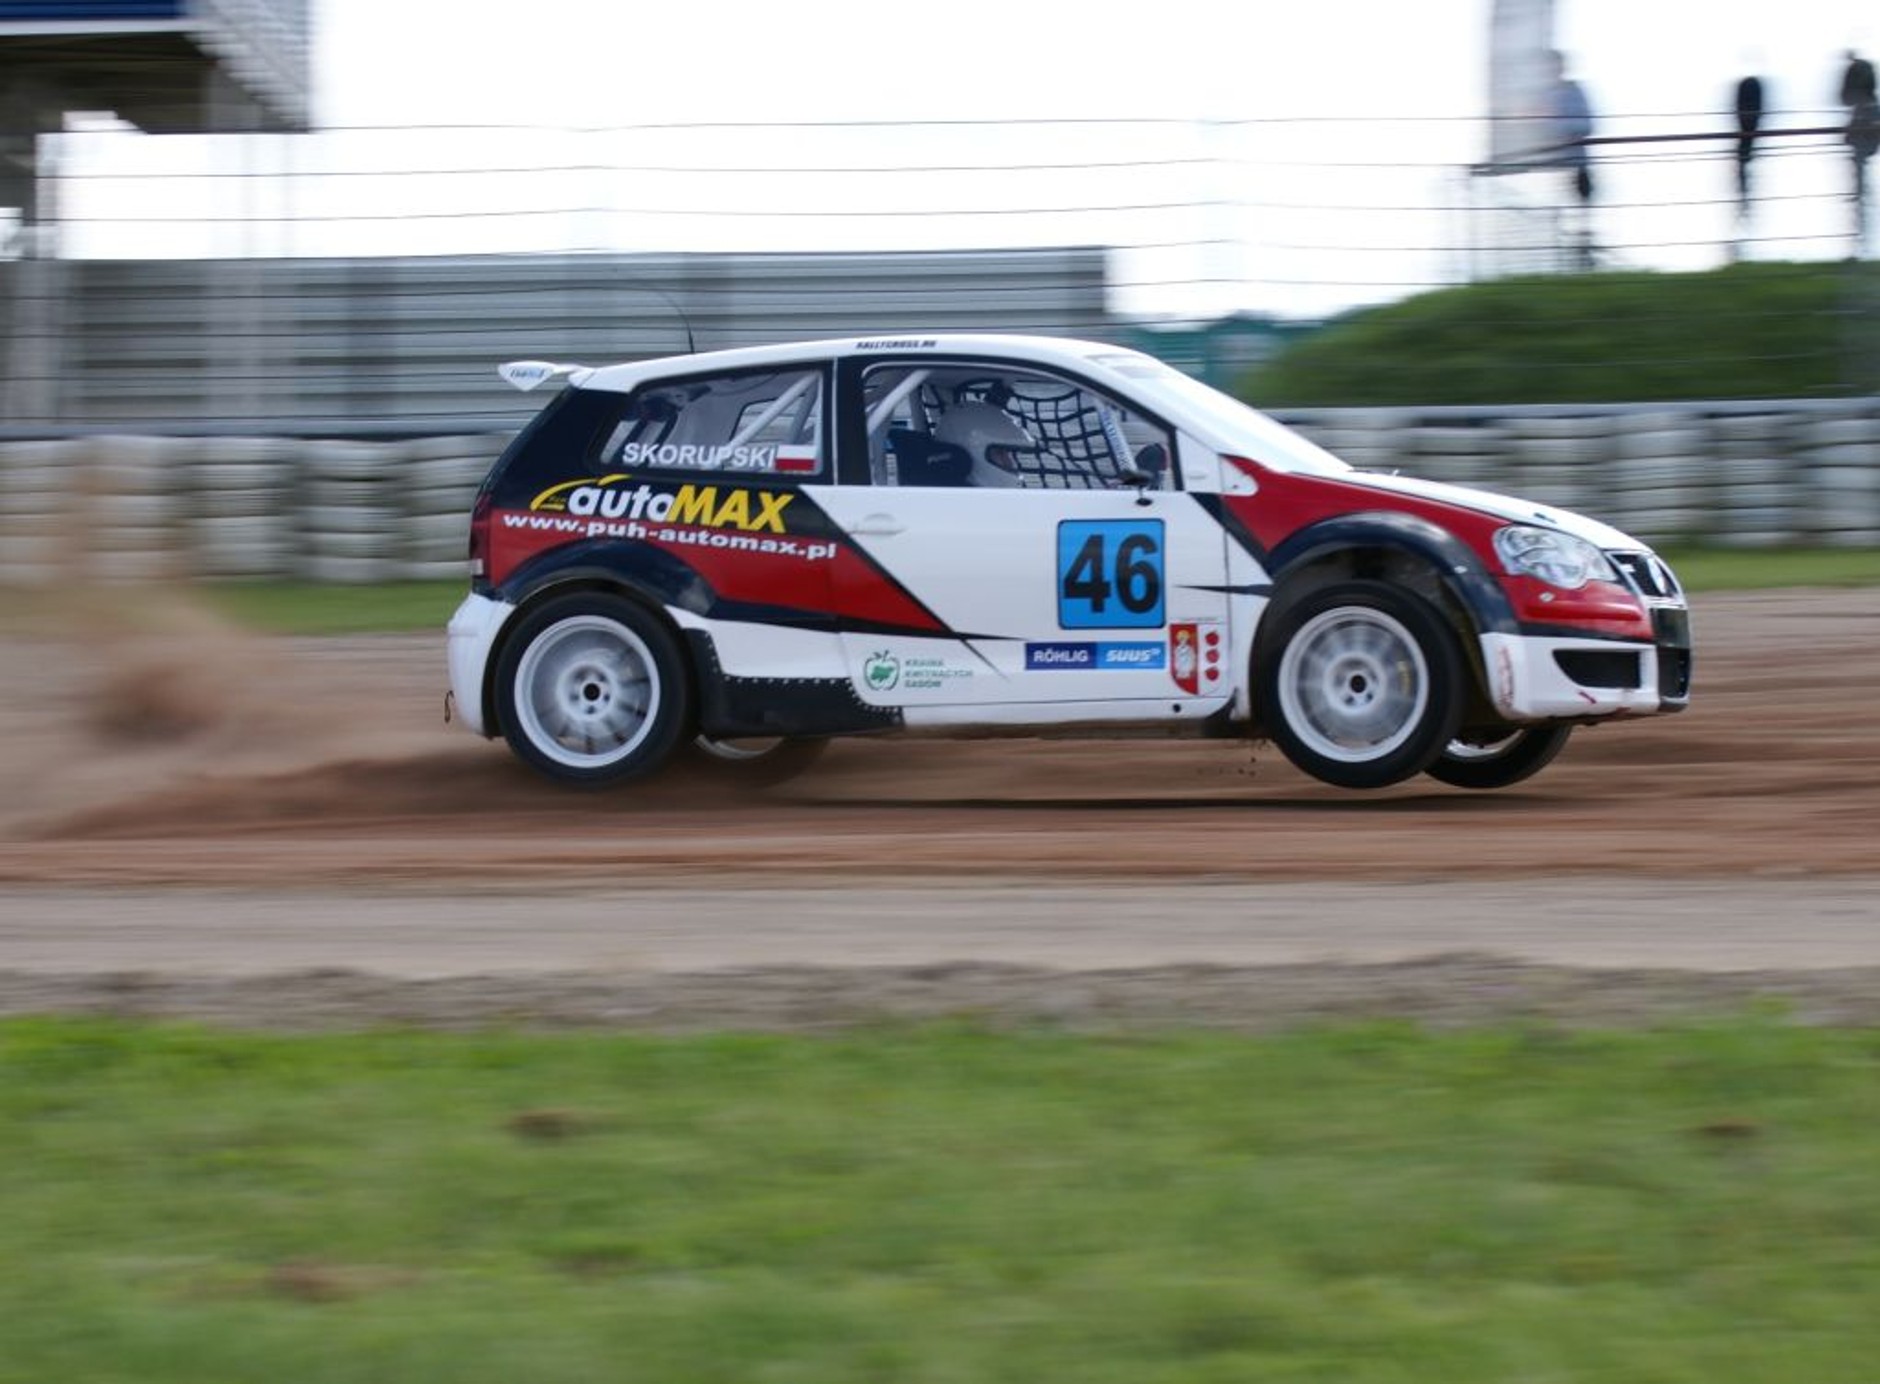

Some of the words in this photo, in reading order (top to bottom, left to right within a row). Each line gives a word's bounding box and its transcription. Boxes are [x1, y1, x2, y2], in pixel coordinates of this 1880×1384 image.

[622, 441, 775, 469] SKORUPSKI
[567, 483, 794, 533] autoMAX
[503, 513, 837, 559] www.puh-automax.pl
[1062, 533, 1161, 614] 46
